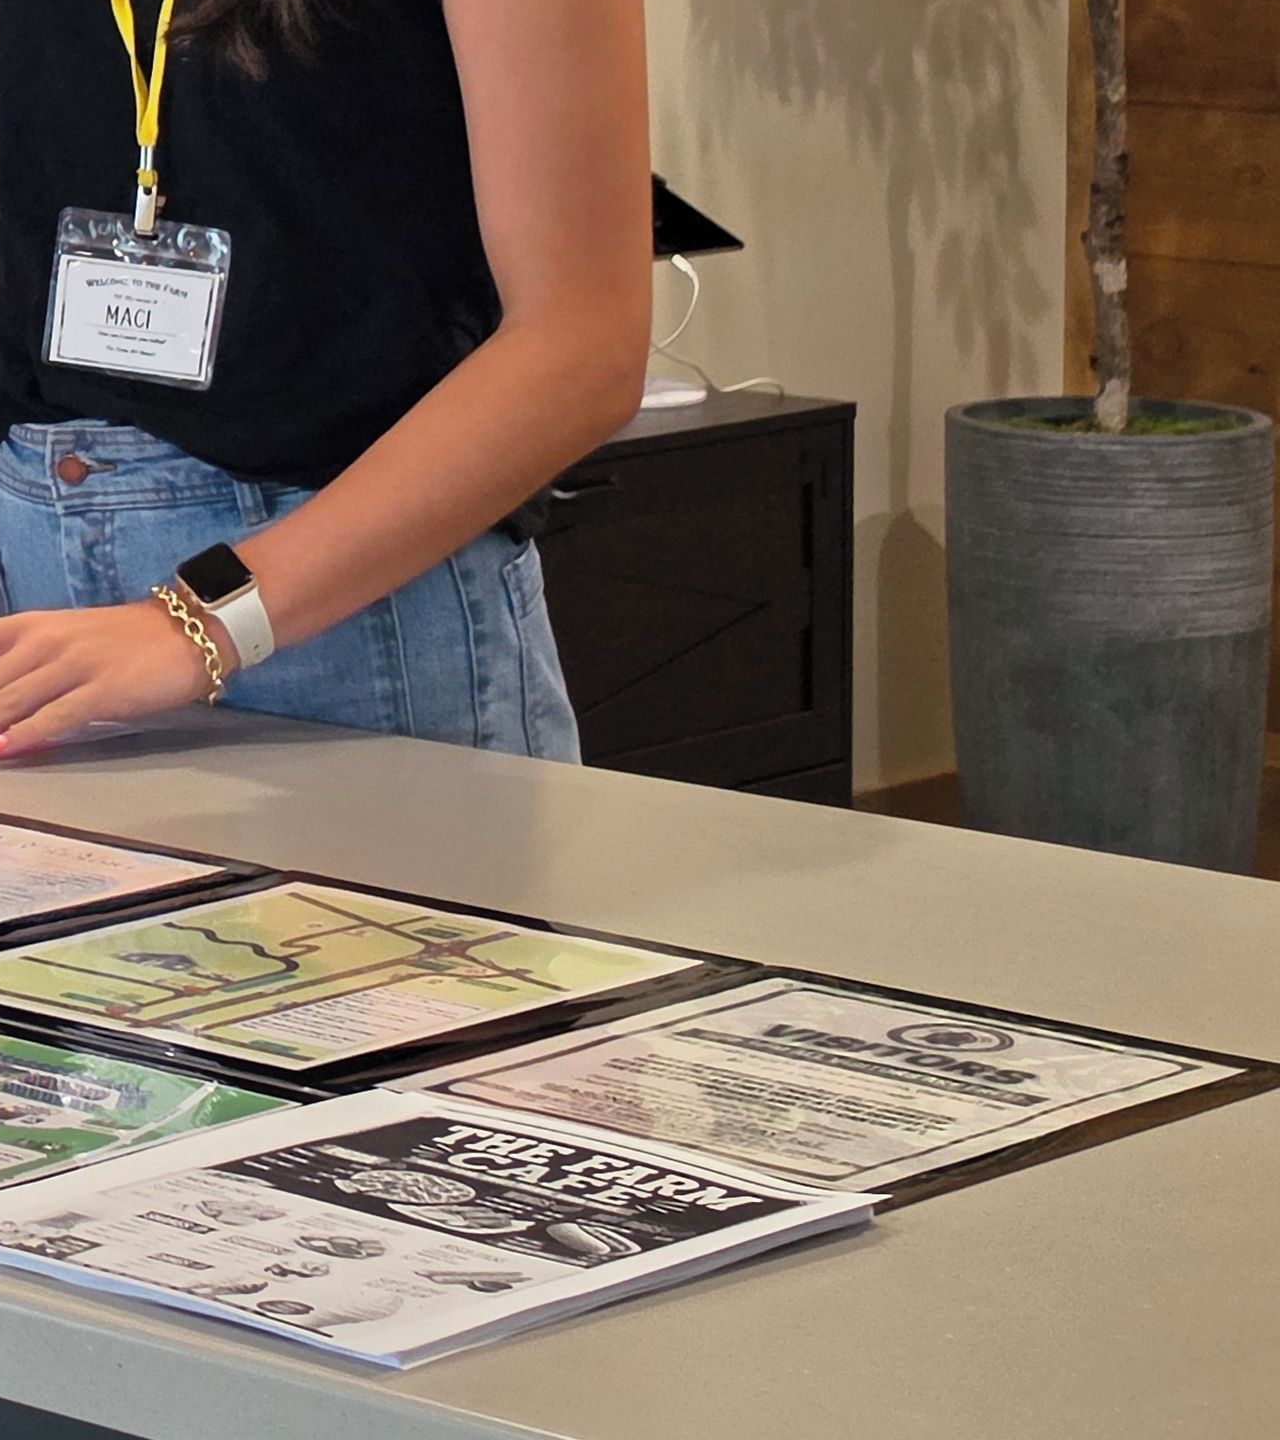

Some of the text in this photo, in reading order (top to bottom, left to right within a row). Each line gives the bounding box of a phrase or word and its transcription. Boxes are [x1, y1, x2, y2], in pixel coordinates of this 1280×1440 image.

[105, 304, 151, 329] MACI
[761, 1023, 1037, 1085] VISITORS
[432, 1124, 577, 1165] THE
[561, 1154, 764, 1212] FARM
[448, 1152, 646, 1207] CAFE
